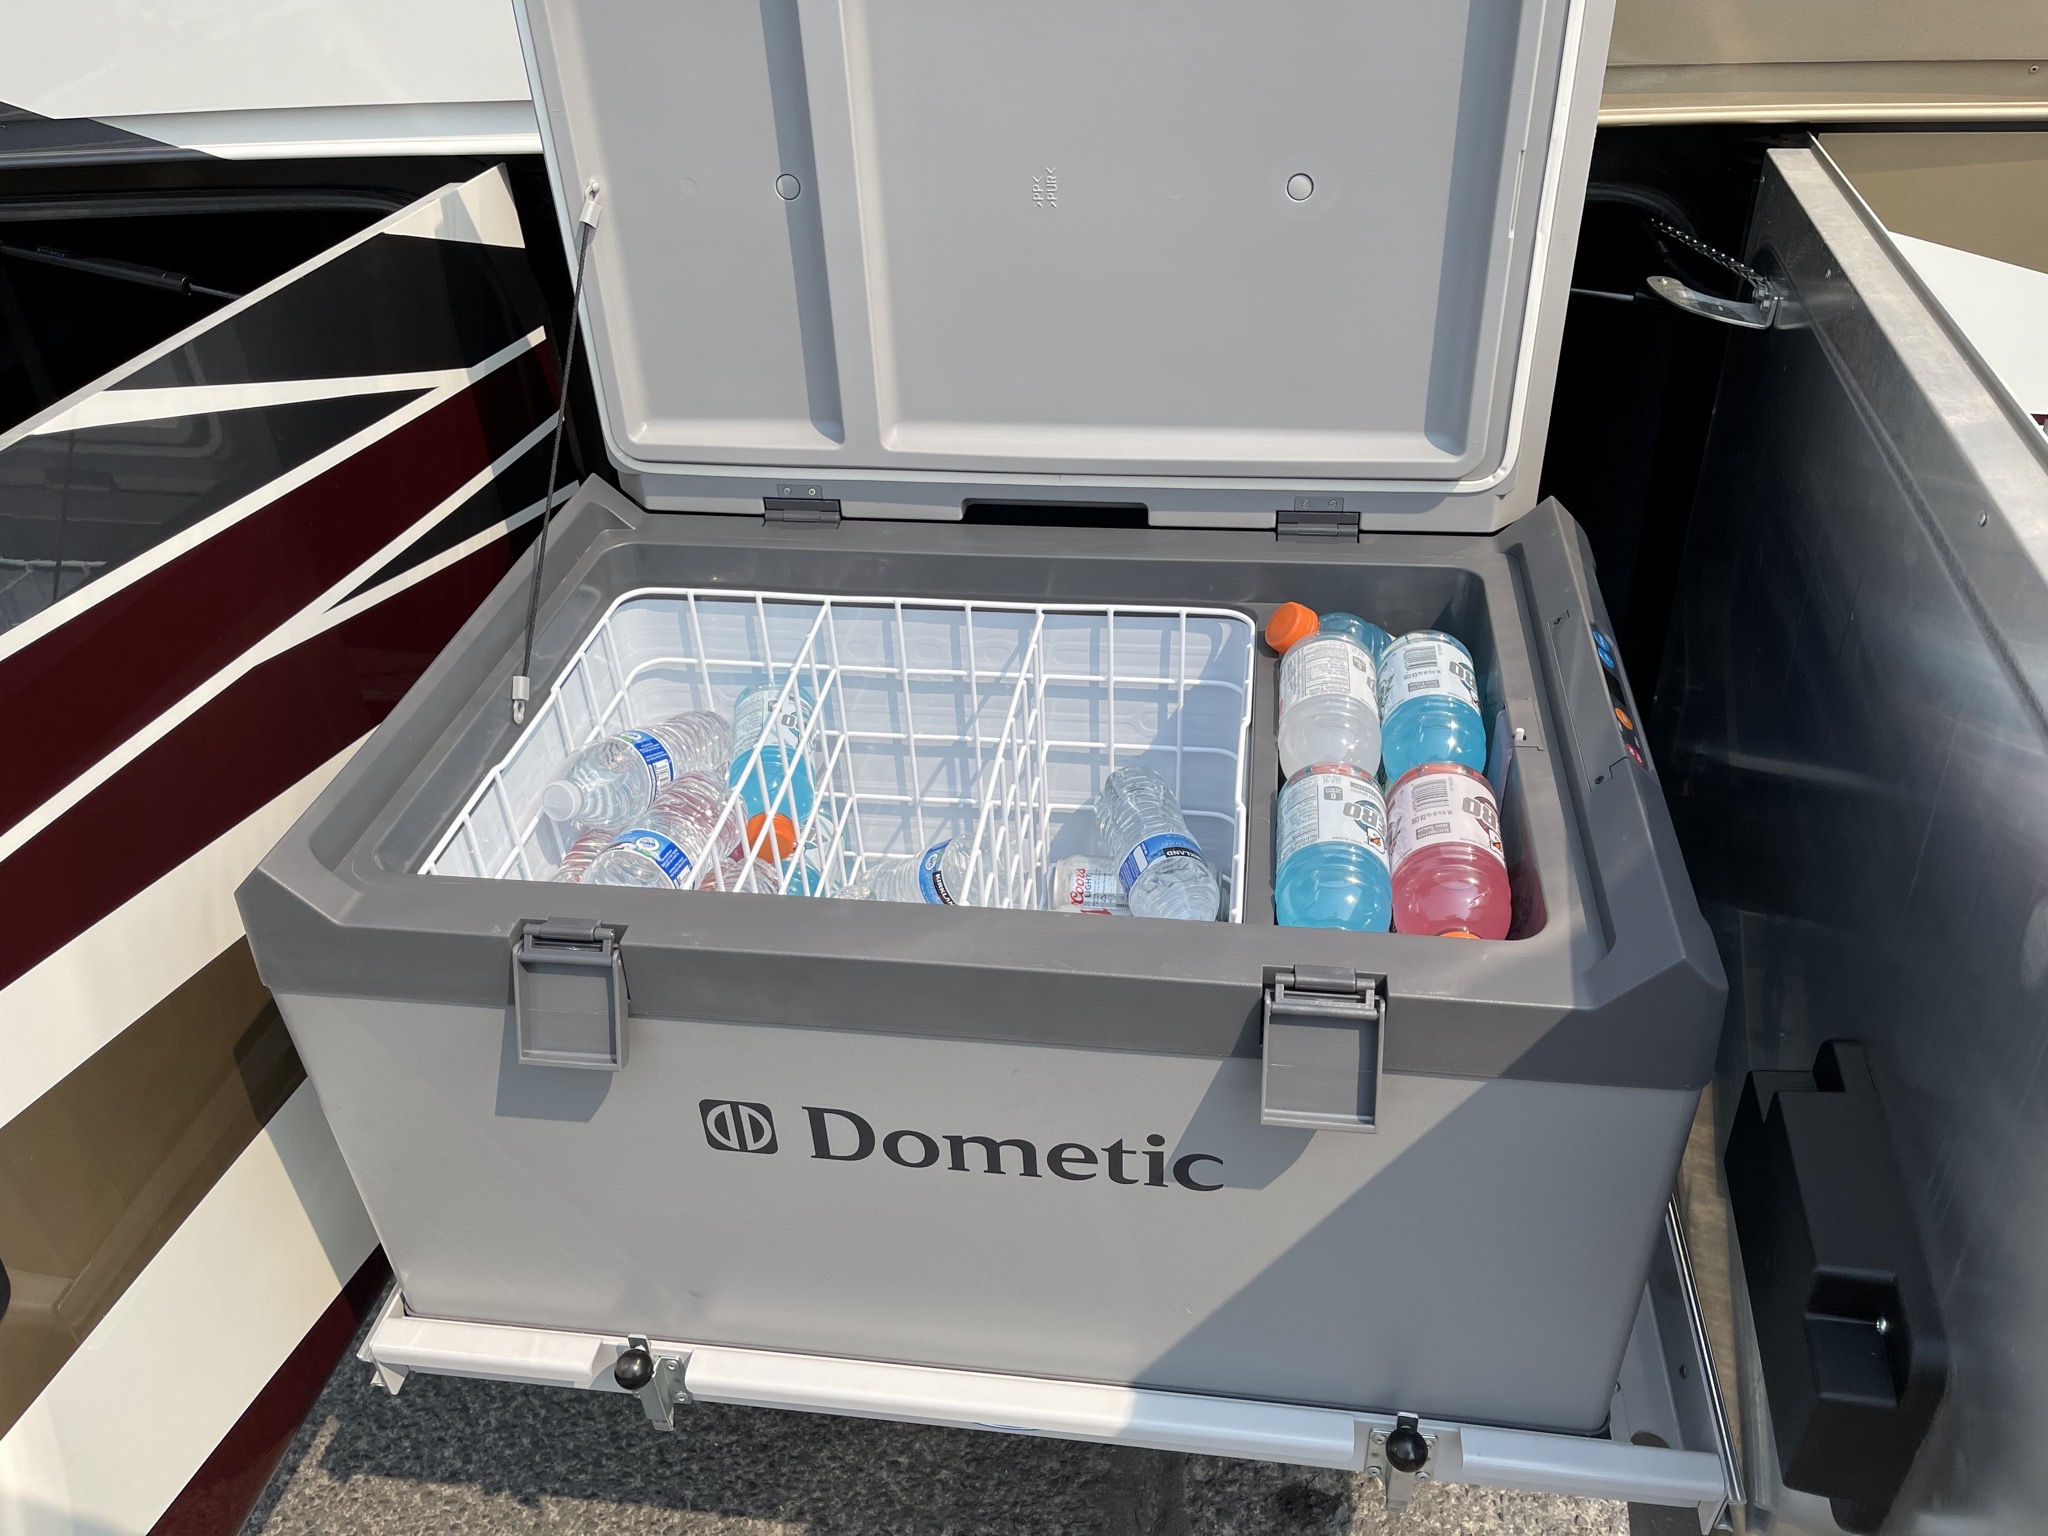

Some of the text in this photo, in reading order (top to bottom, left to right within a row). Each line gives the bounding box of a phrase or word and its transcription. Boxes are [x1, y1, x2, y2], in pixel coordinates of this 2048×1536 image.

[1343, 802, 1385, 834] ERO
[1462, 797, 1497, 830] RO
[1166, 850, 1205, 864] RKLAND
[936, 873, 956, 905] KIRKLAN
[1070, 868, 1087, 905] Coors
[1084, 873, 1093, 898] LIGHT
[801, 1105, 1225, 1192] Dometic
